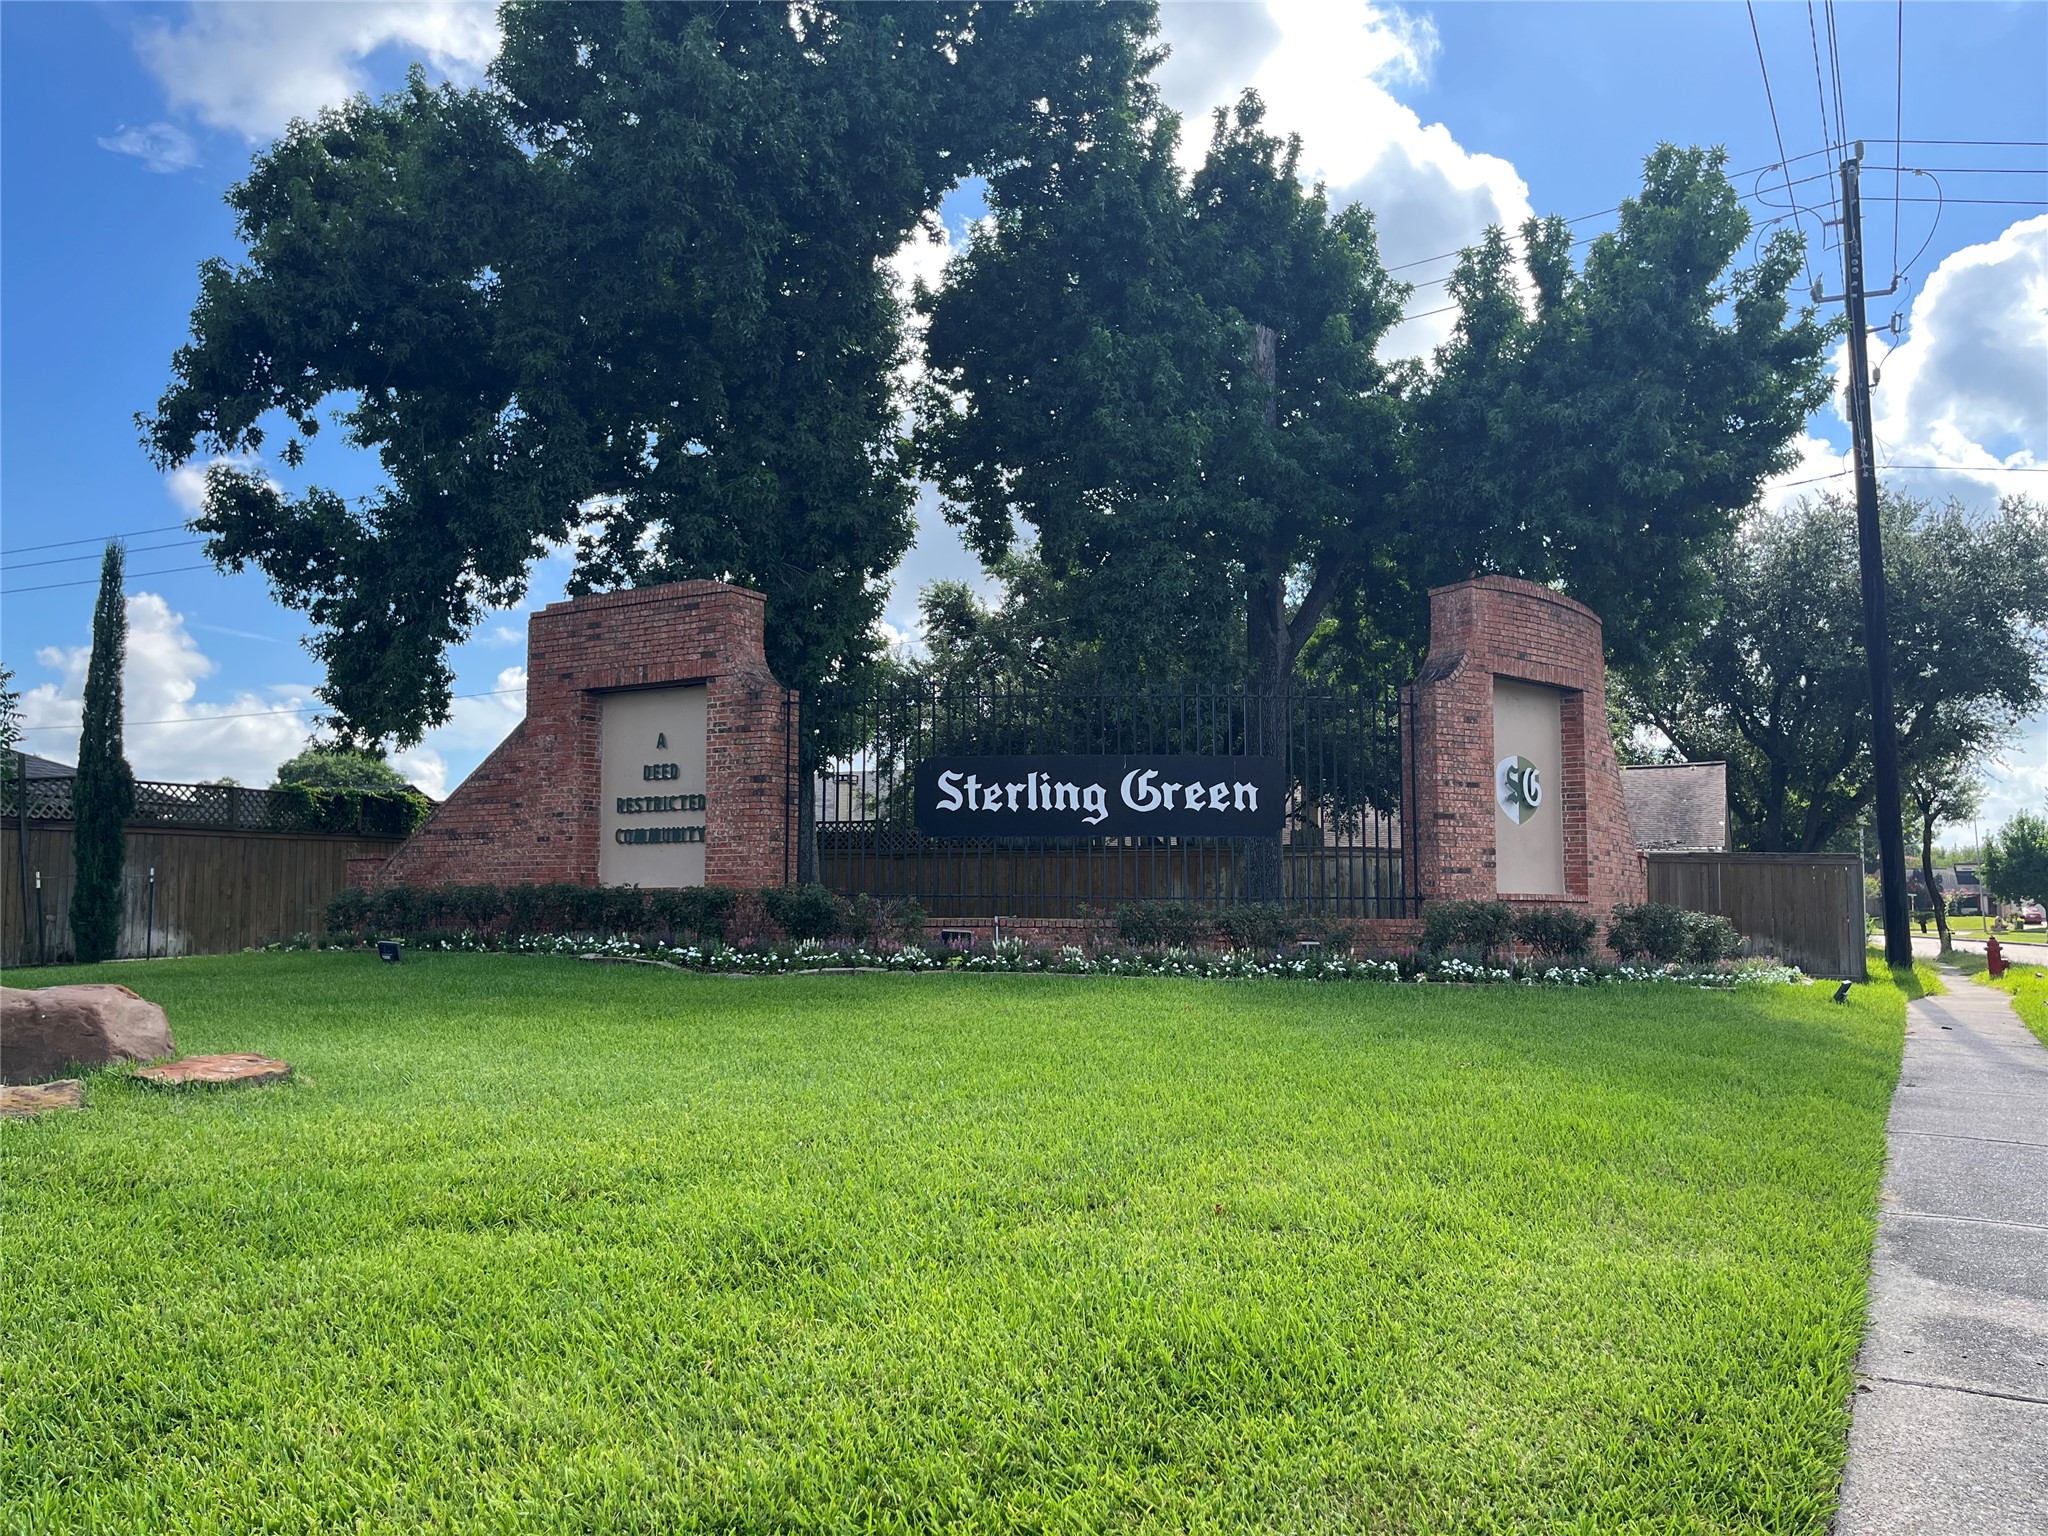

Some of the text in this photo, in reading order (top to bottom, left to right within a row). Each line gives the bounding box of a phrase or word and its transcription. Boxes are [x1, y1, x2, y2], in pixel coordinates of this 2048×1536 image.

[656, 732, 666, 749] A
[644, 763, 679, 781] DEED
[617, 794, 706, 814] RESTRICTED
[936, 768, 1259, 825] Sterling Green
[616, 826, 705, 845] COMMUNITY
